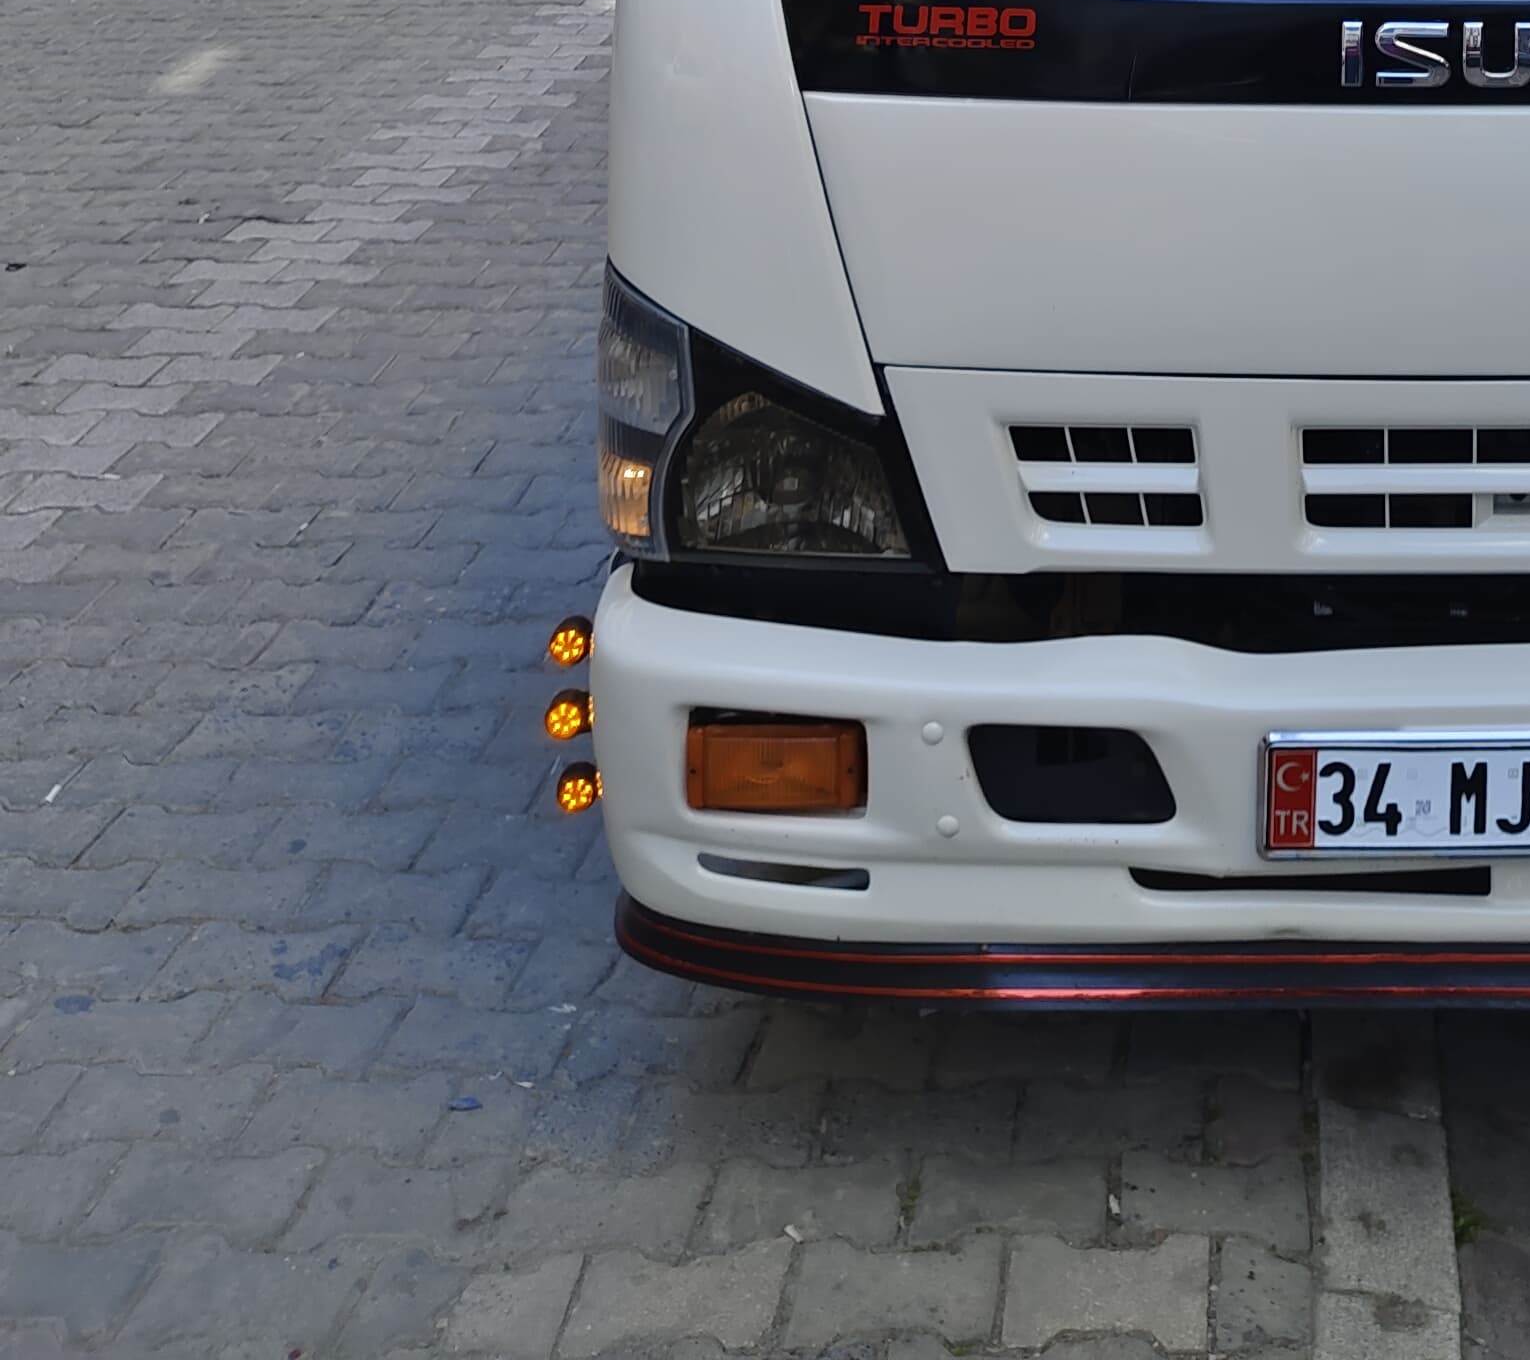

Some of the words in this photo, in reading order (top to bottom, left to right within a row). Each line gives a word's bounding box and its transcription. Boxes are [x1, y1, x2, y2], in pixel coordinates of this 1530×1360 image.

[859, 5, 1037, 37] TURBO
[856, 35, 1036, 49] INTERCOOLED
[1318, 762, 1402, 835] 34
[1275, 810, 1308, 837] TR
